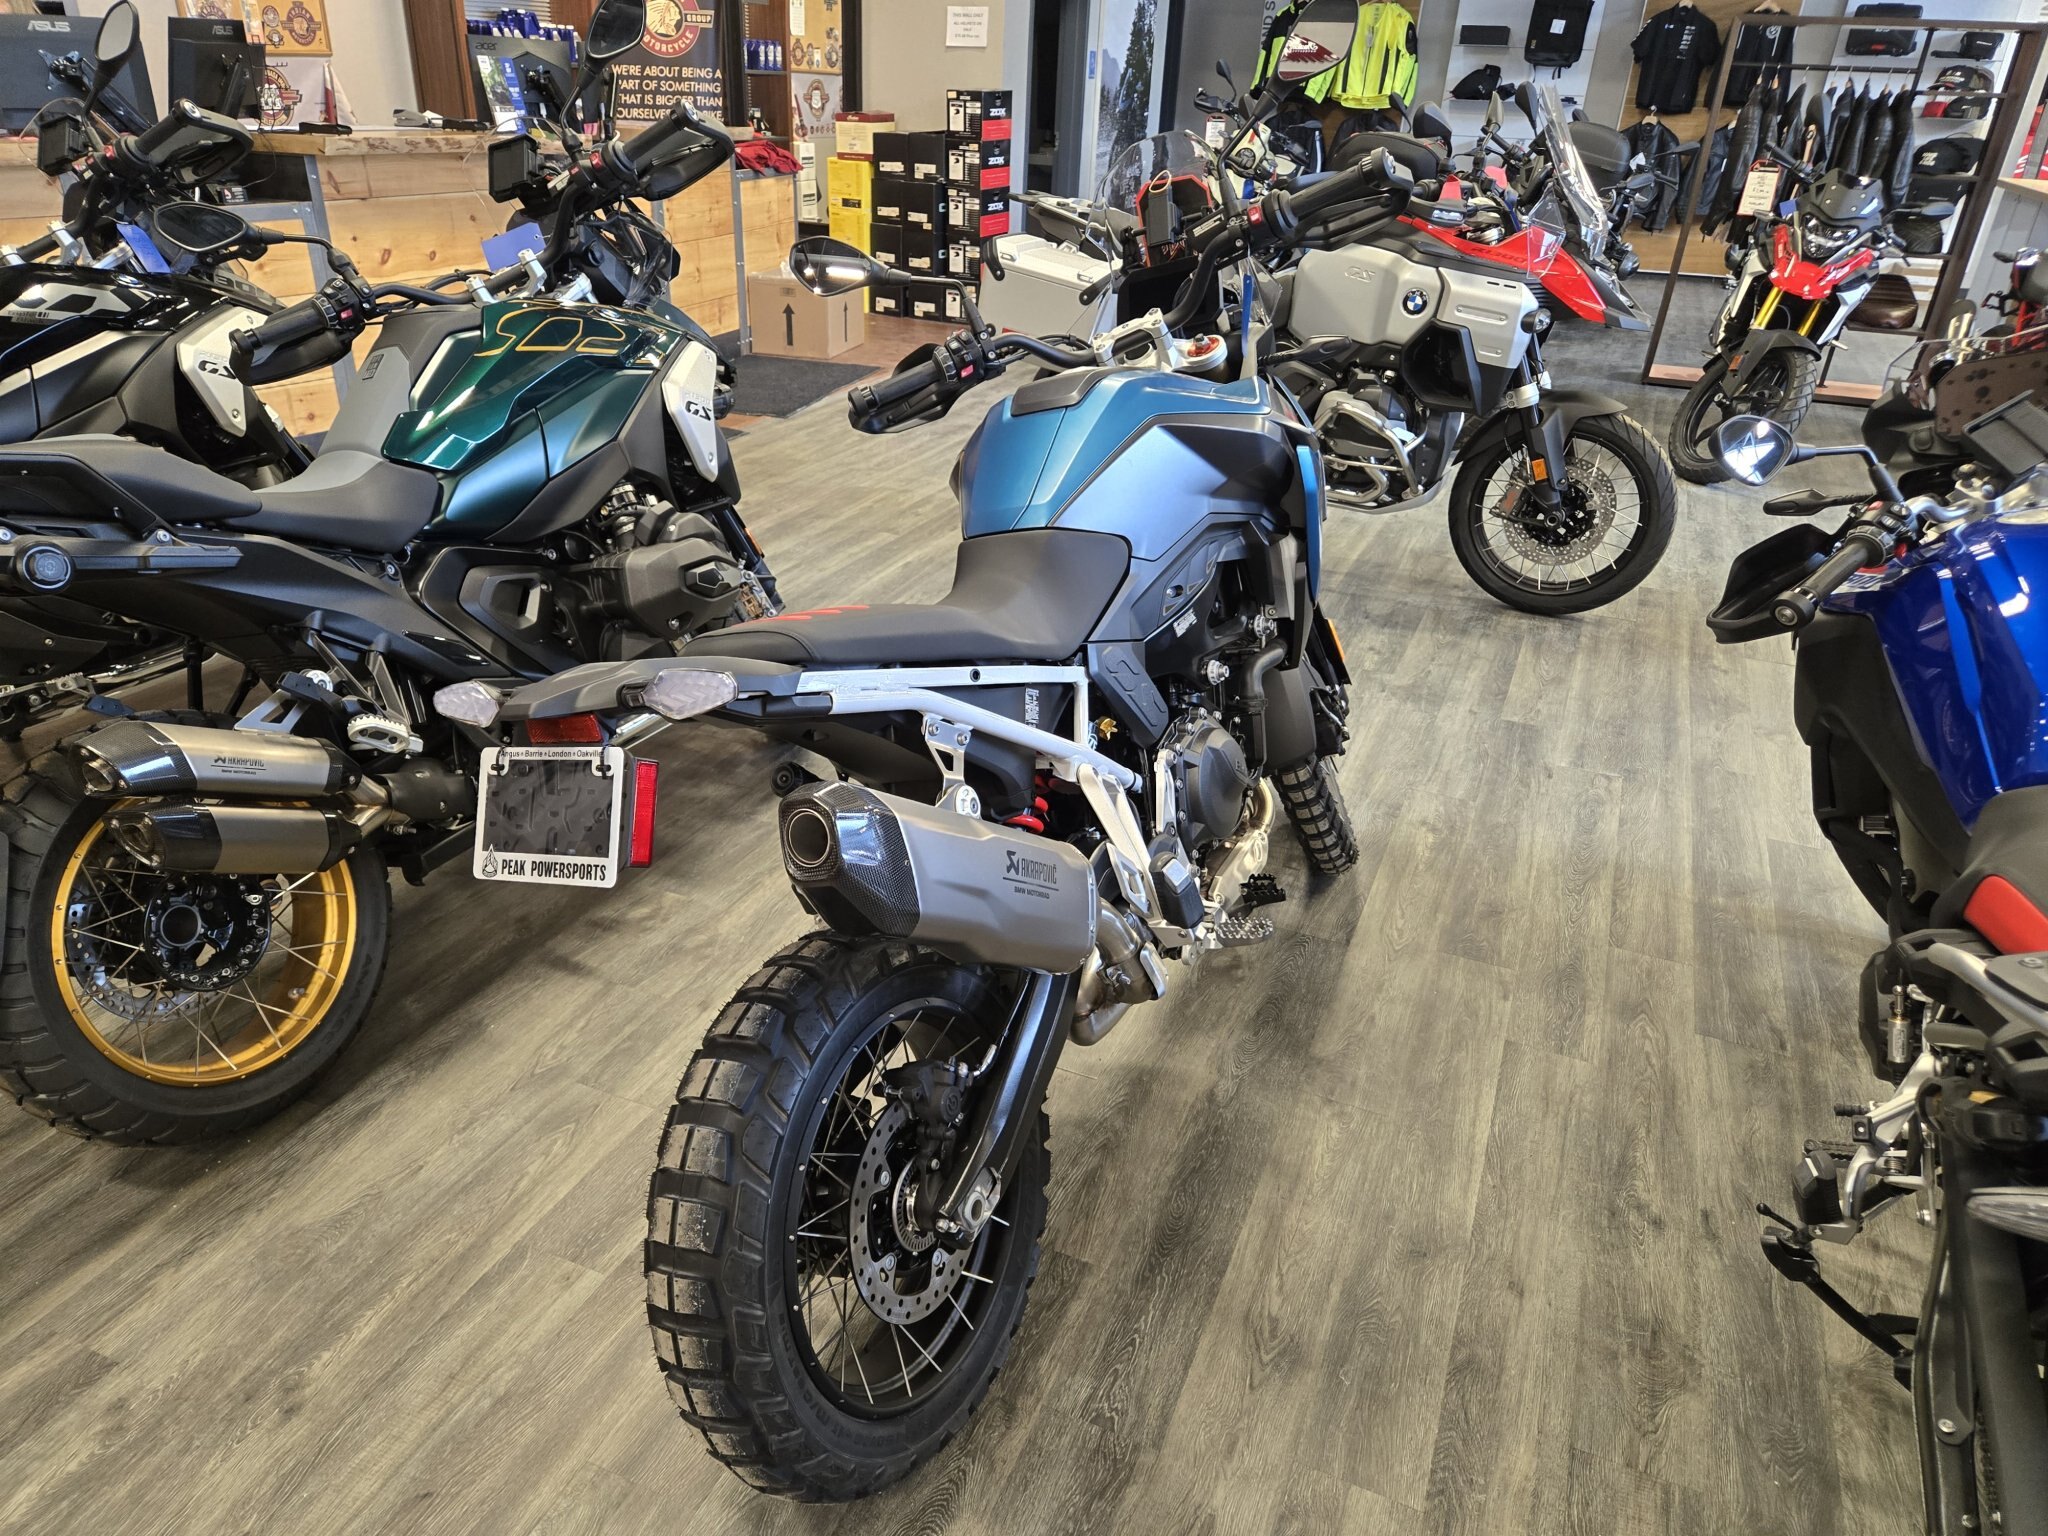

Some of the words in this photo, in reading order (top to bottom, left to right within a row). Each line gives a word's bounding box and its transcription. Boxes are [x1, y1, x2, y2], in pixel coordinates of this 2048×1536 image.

[686, 14, 712, 23] GROUP
[27, 20, 71, 32] ASUS
[211, 25, 234, 35] ASUS
[475, 42, 498, 51] acer
[642, 29, 694, 53] OTORCYCLE
[611, 64, 642, 76] WE'RE
[643, 66, 680, 77] ABOUT
[681, 67, 713, 78] BEING
[714, 69, 722, 79] A
[642, 80, 658, 91] OF
[660, 81, 721, 93] SOMETHING
[644, 94, 654, 105] IS
[695, 96, 722, 107] THAN
[989, 108, 1007, 117] ZOX
[988, 156, 1005, 165] ZOX
[987, 201, 1004, 210] ZOX
[685, 400, 712, 421] GS
[525, 750, 543, 758] Barrie
[548, 750, 572, 758] London
[501, 859, 527, 876] PEAK
[530, 860, 607, 882] POWERSPORTS
[1014, 886, 1026, 894] BMW
[1026, 889, 1050, 899] MOTORRAD
